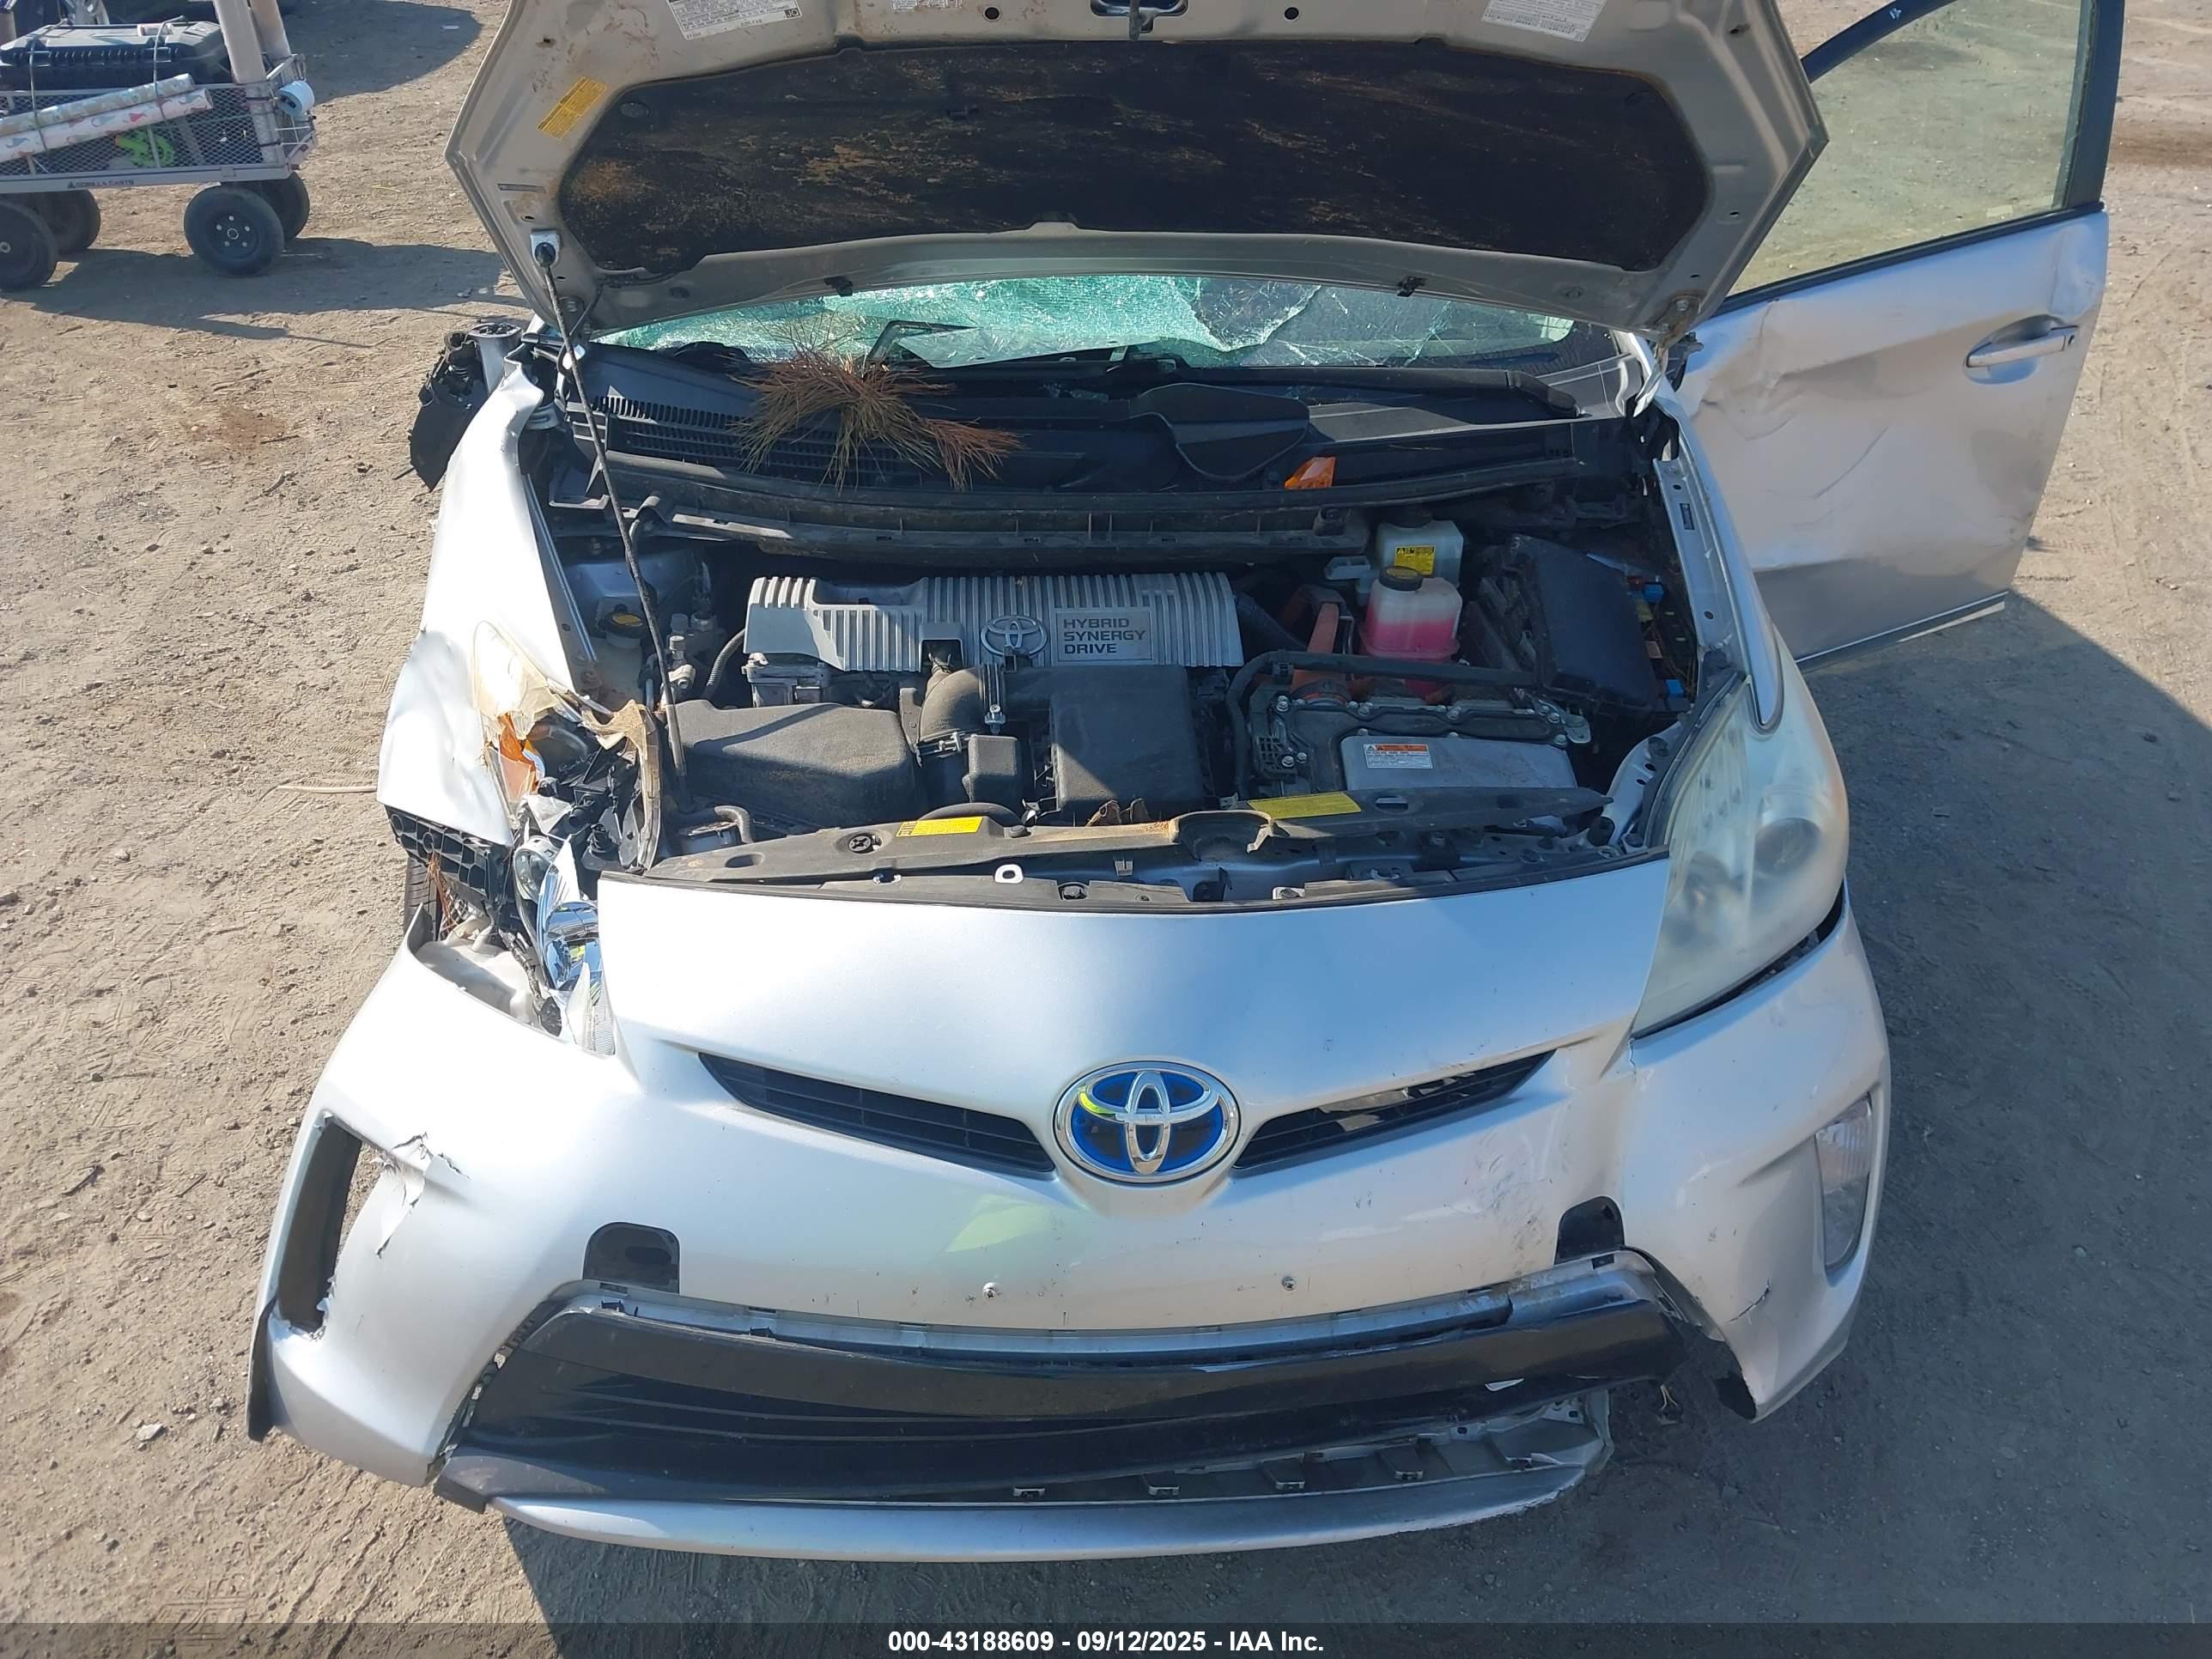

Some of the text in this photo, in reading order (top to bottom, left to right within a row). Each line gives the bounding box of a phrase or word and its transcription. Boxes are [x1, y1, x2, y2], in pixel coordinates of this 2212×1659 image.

[1064, 618, 1129, 629] HYBRID
[1064, 630, 1146, 641] SYNERGY
[1064, 643, 1117, 654] DRIVE
